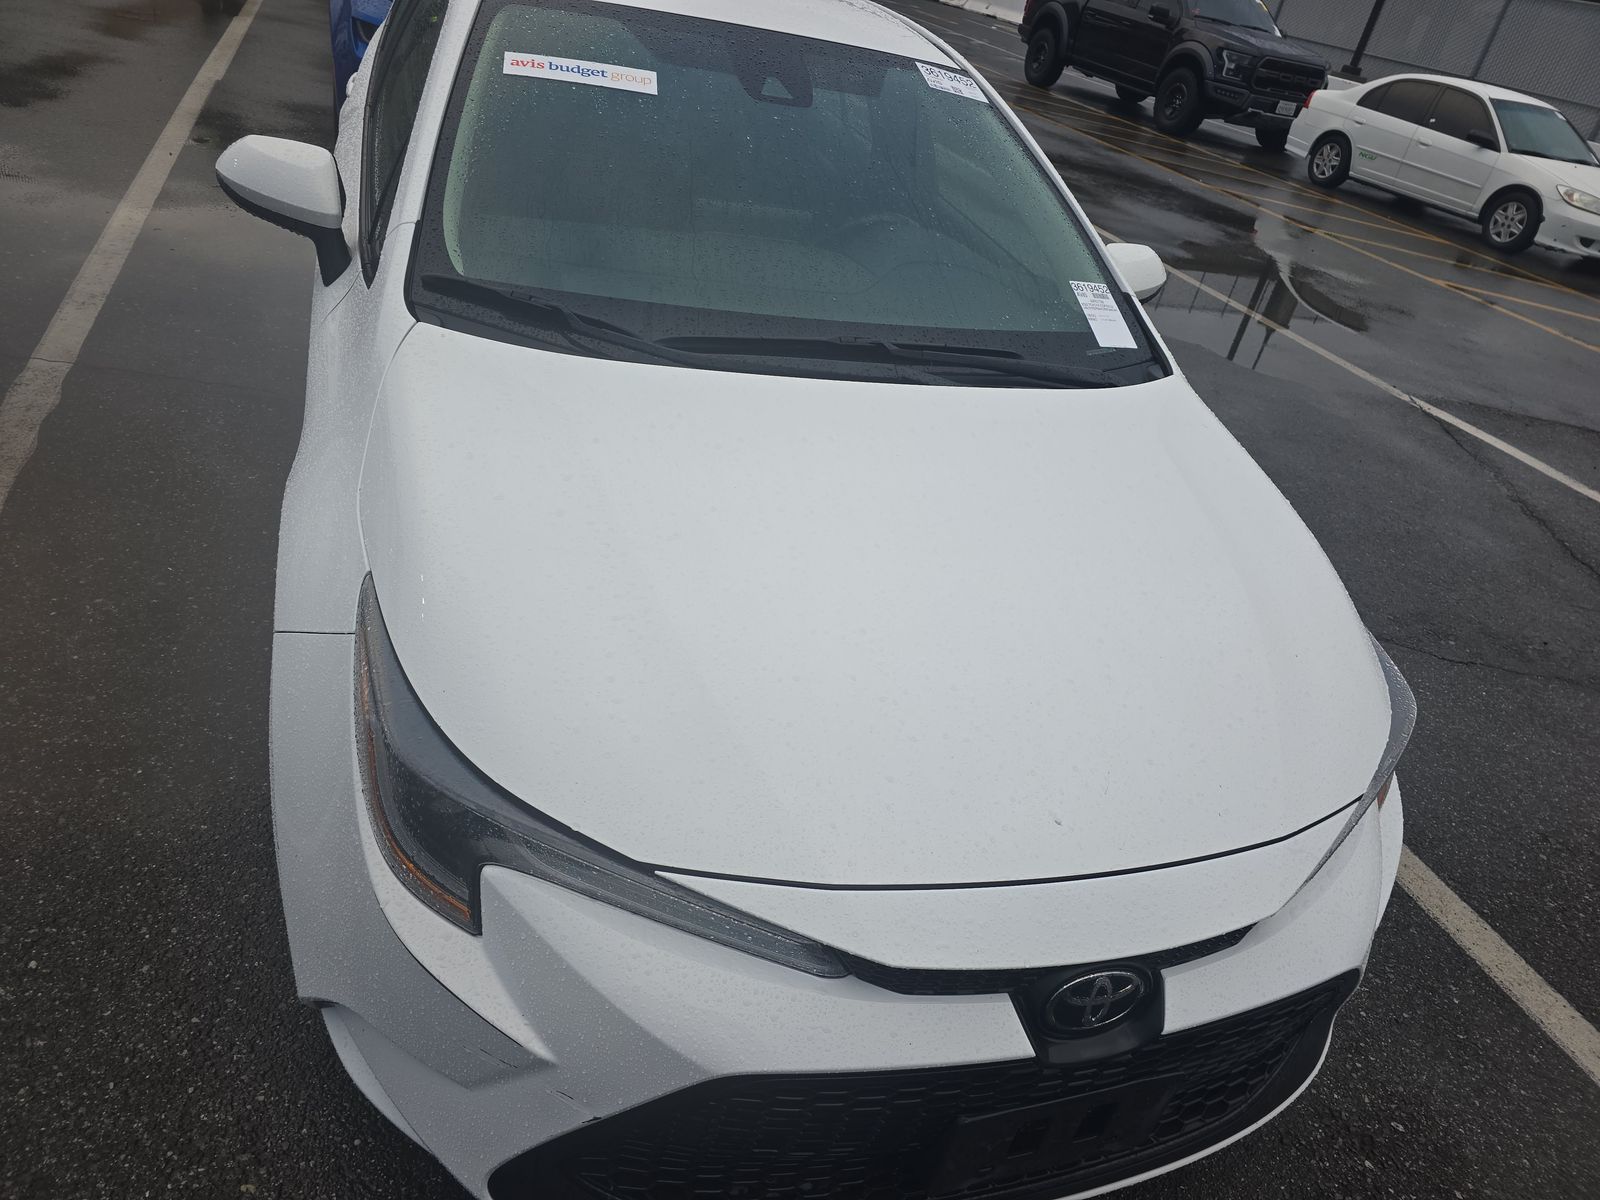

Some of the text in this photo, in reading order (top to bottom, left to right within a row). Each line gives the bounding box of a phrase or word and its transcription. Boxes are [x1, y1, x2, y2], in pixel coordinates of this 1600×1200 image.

[510, 58, 652, 86] avis budget group
[921, 65, 976, 89] 3619452
[1071, 283, 1110, 294] 3619452
